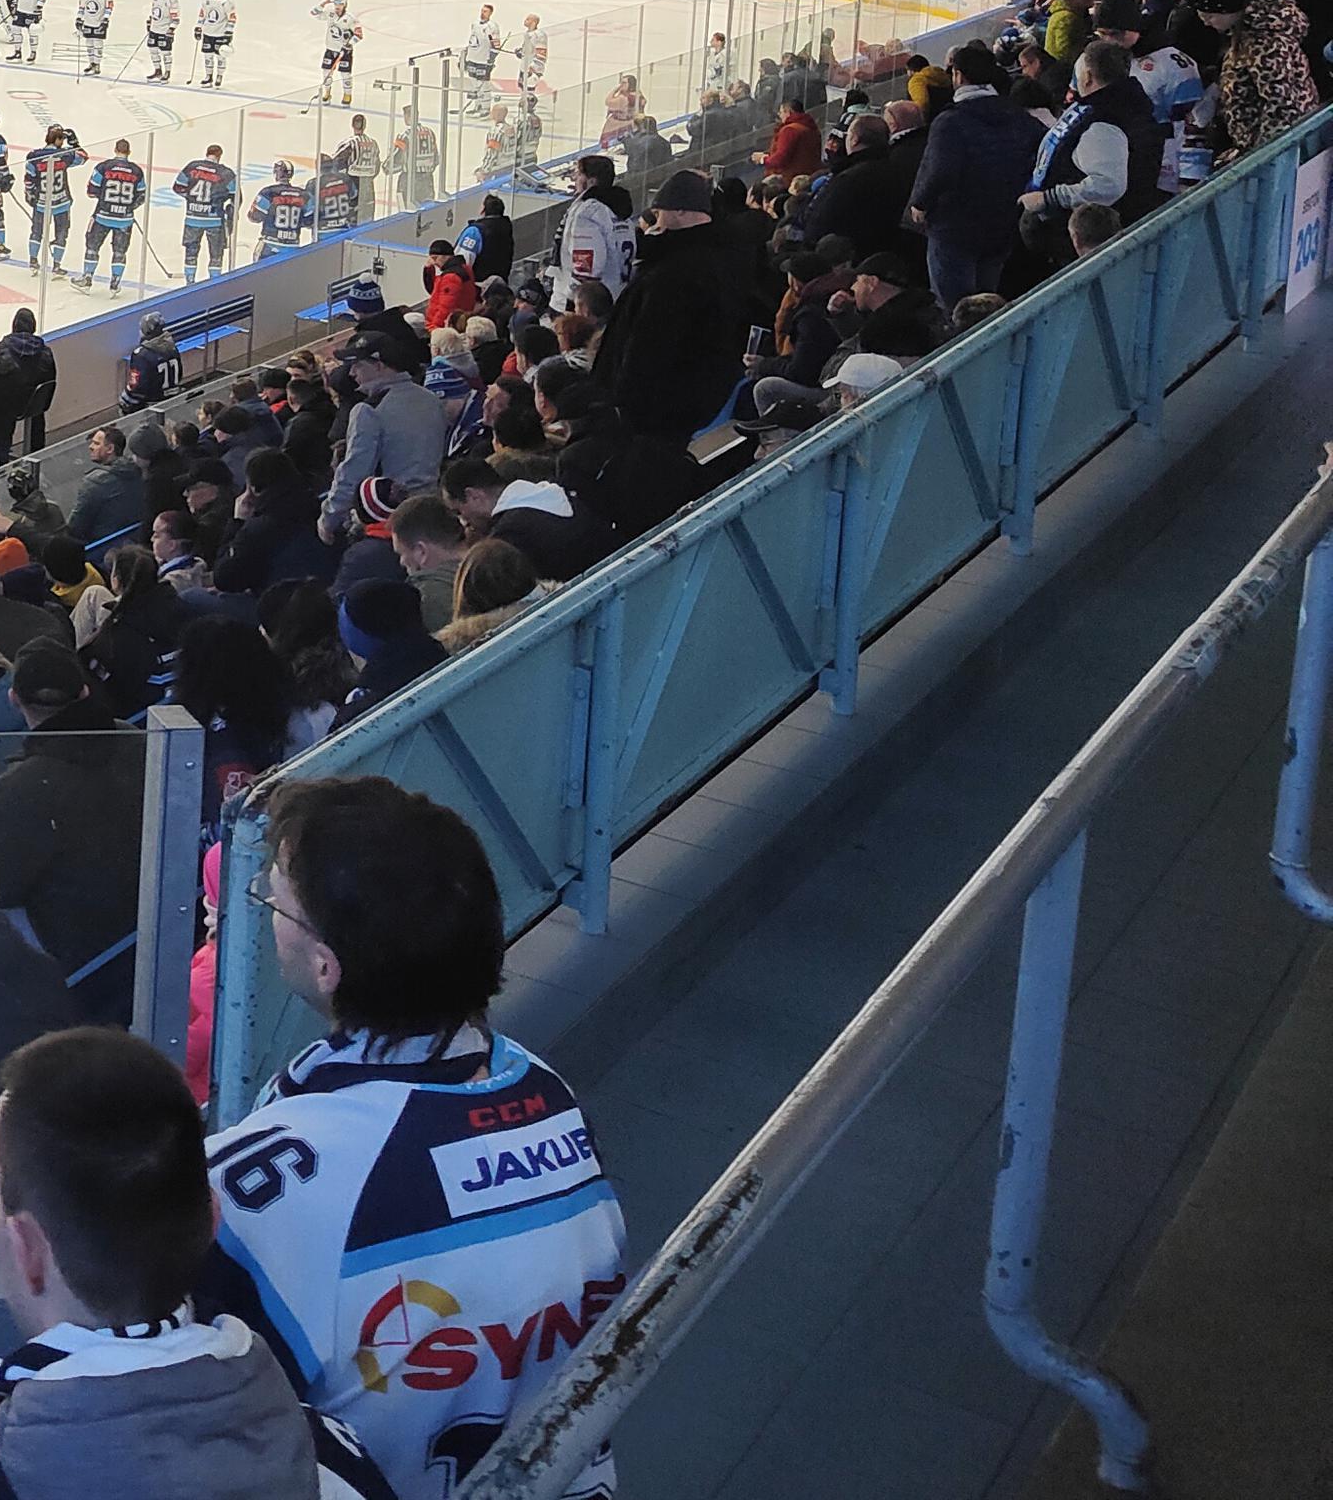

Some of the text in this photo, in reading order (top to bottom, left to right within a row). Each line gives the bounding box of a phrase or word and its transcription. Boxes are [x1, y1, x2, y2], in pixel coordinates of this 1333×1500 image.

[104, 179, 134, 204] 29
[189, 180, 213, 203] 41
[274, 206, 300, 229] 88
[468, 1094, 547, 1129] CCM
